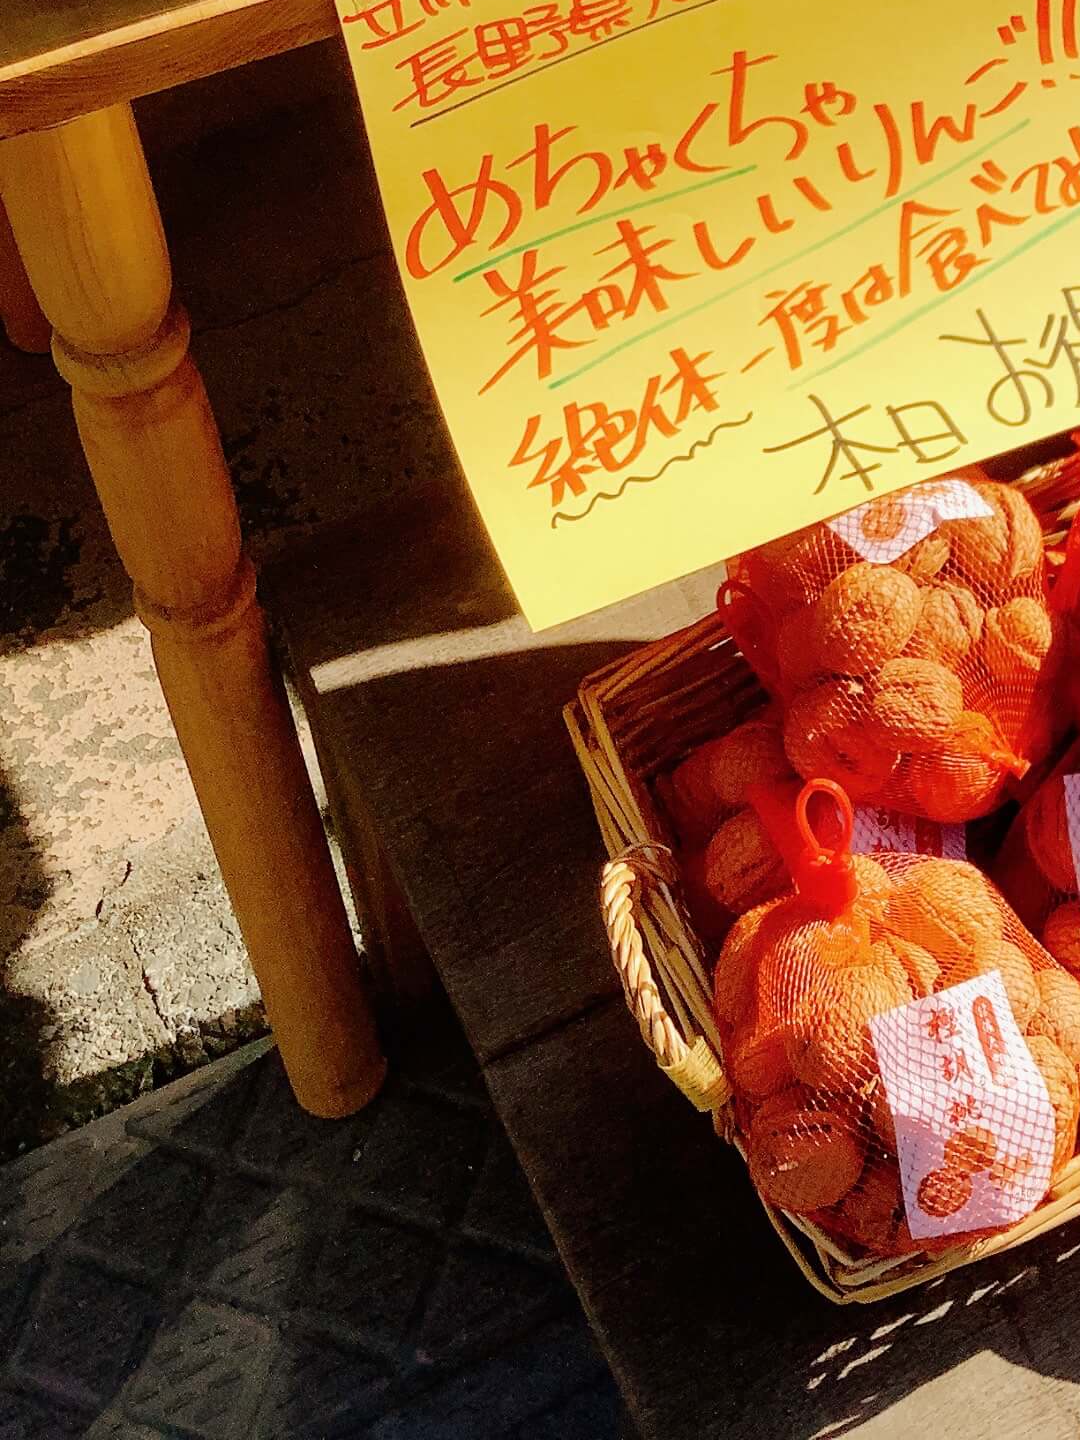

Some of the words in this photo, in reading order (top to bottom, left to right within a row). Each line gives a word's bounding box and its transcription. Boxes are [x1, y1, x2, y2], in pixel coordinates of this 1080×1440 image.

[405, 50, 856, 280] めちゃくちゃ
